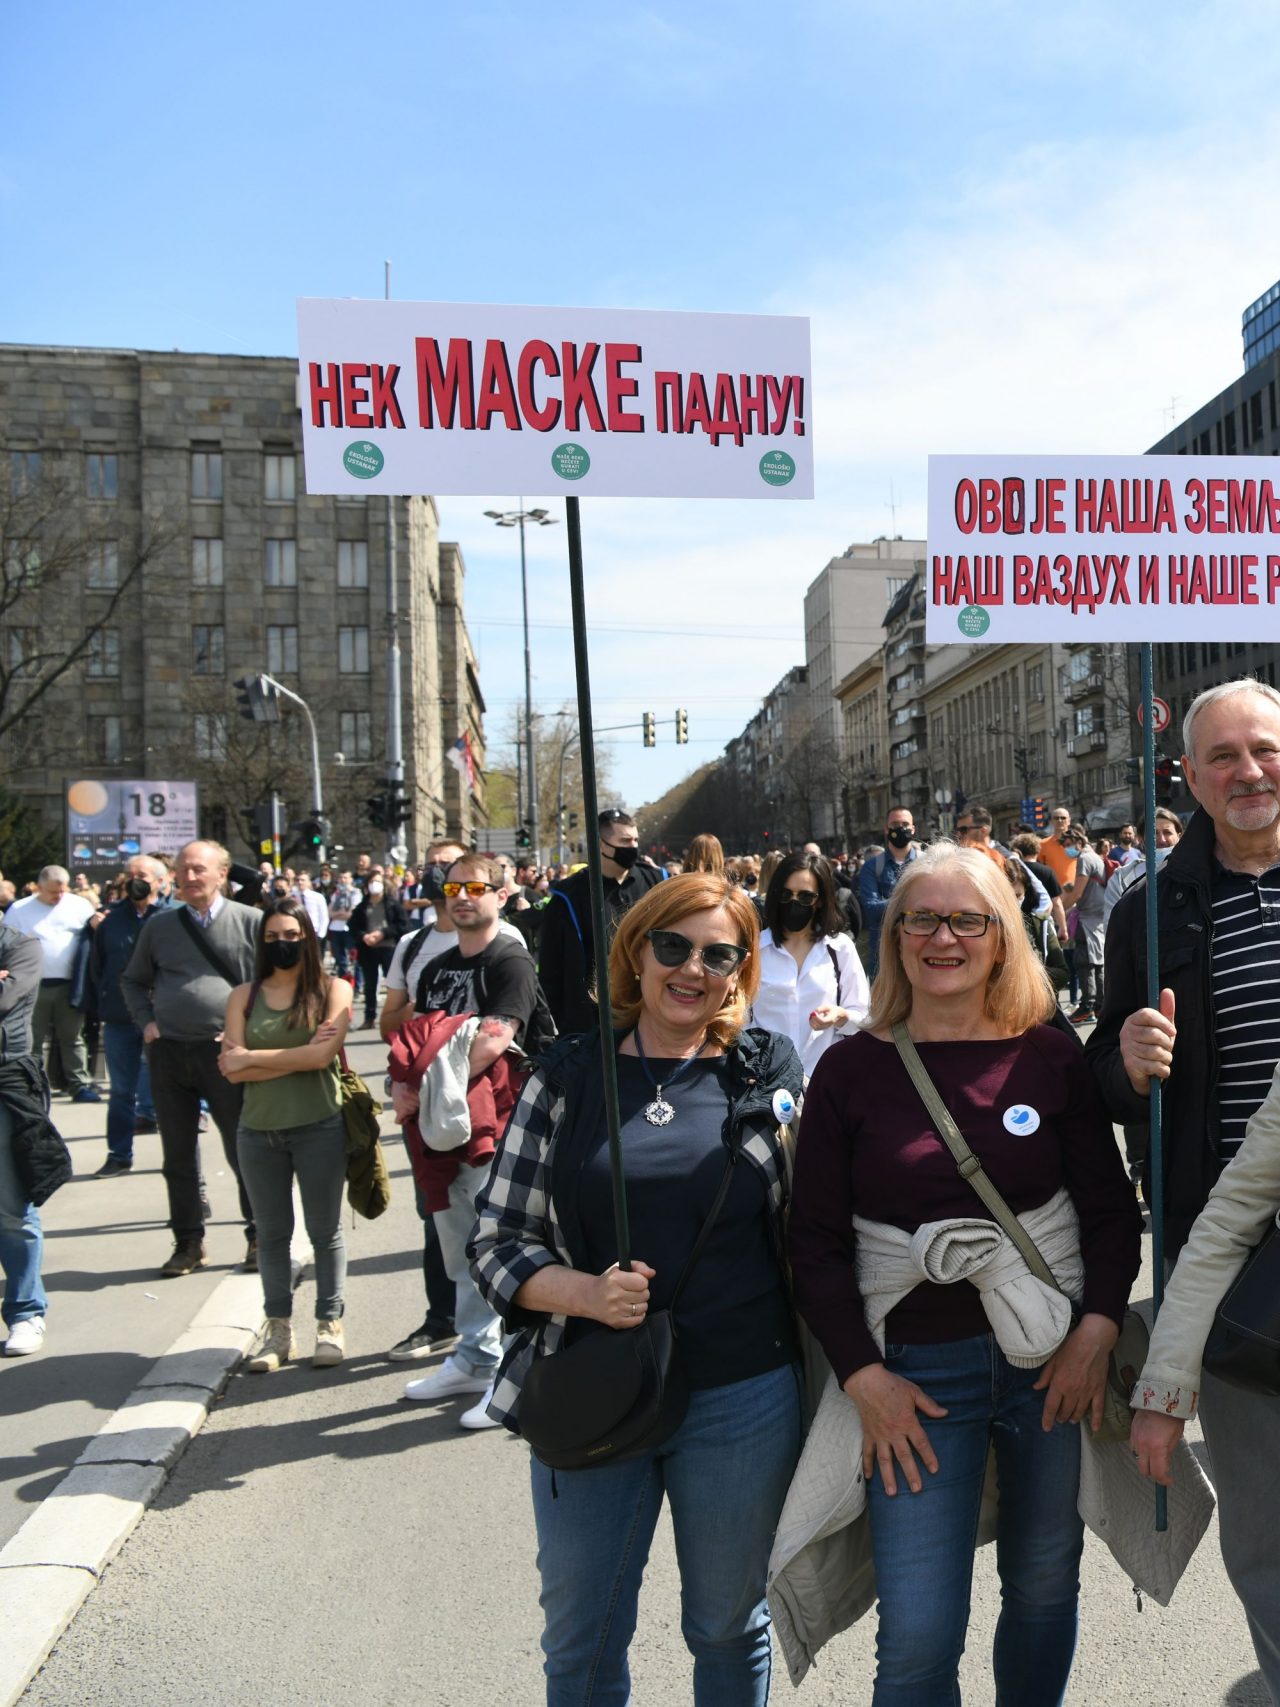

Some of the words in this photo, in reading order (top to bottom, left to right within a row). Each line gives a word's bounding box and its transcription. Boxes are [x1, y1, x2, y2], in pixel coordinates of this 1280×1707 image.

[308, 362, 407, 430] НЕК
[415, 337, 645, 433] МАСКЕ
[655, 371, 806, 448] ПАДНУ!
[954, 476, 1026, 536] ОВО
[1030, 478, 1067, 535] ЈЕ
[1075, 478, 1178, 534] НАША
[932, 555, 1004, 606] НАШ
[1013, 554, 1132, 615] ВАЗДУХ
[1138, 554, 1160, 605] И
[1168, 554, 1260, 605] НАШЕ
